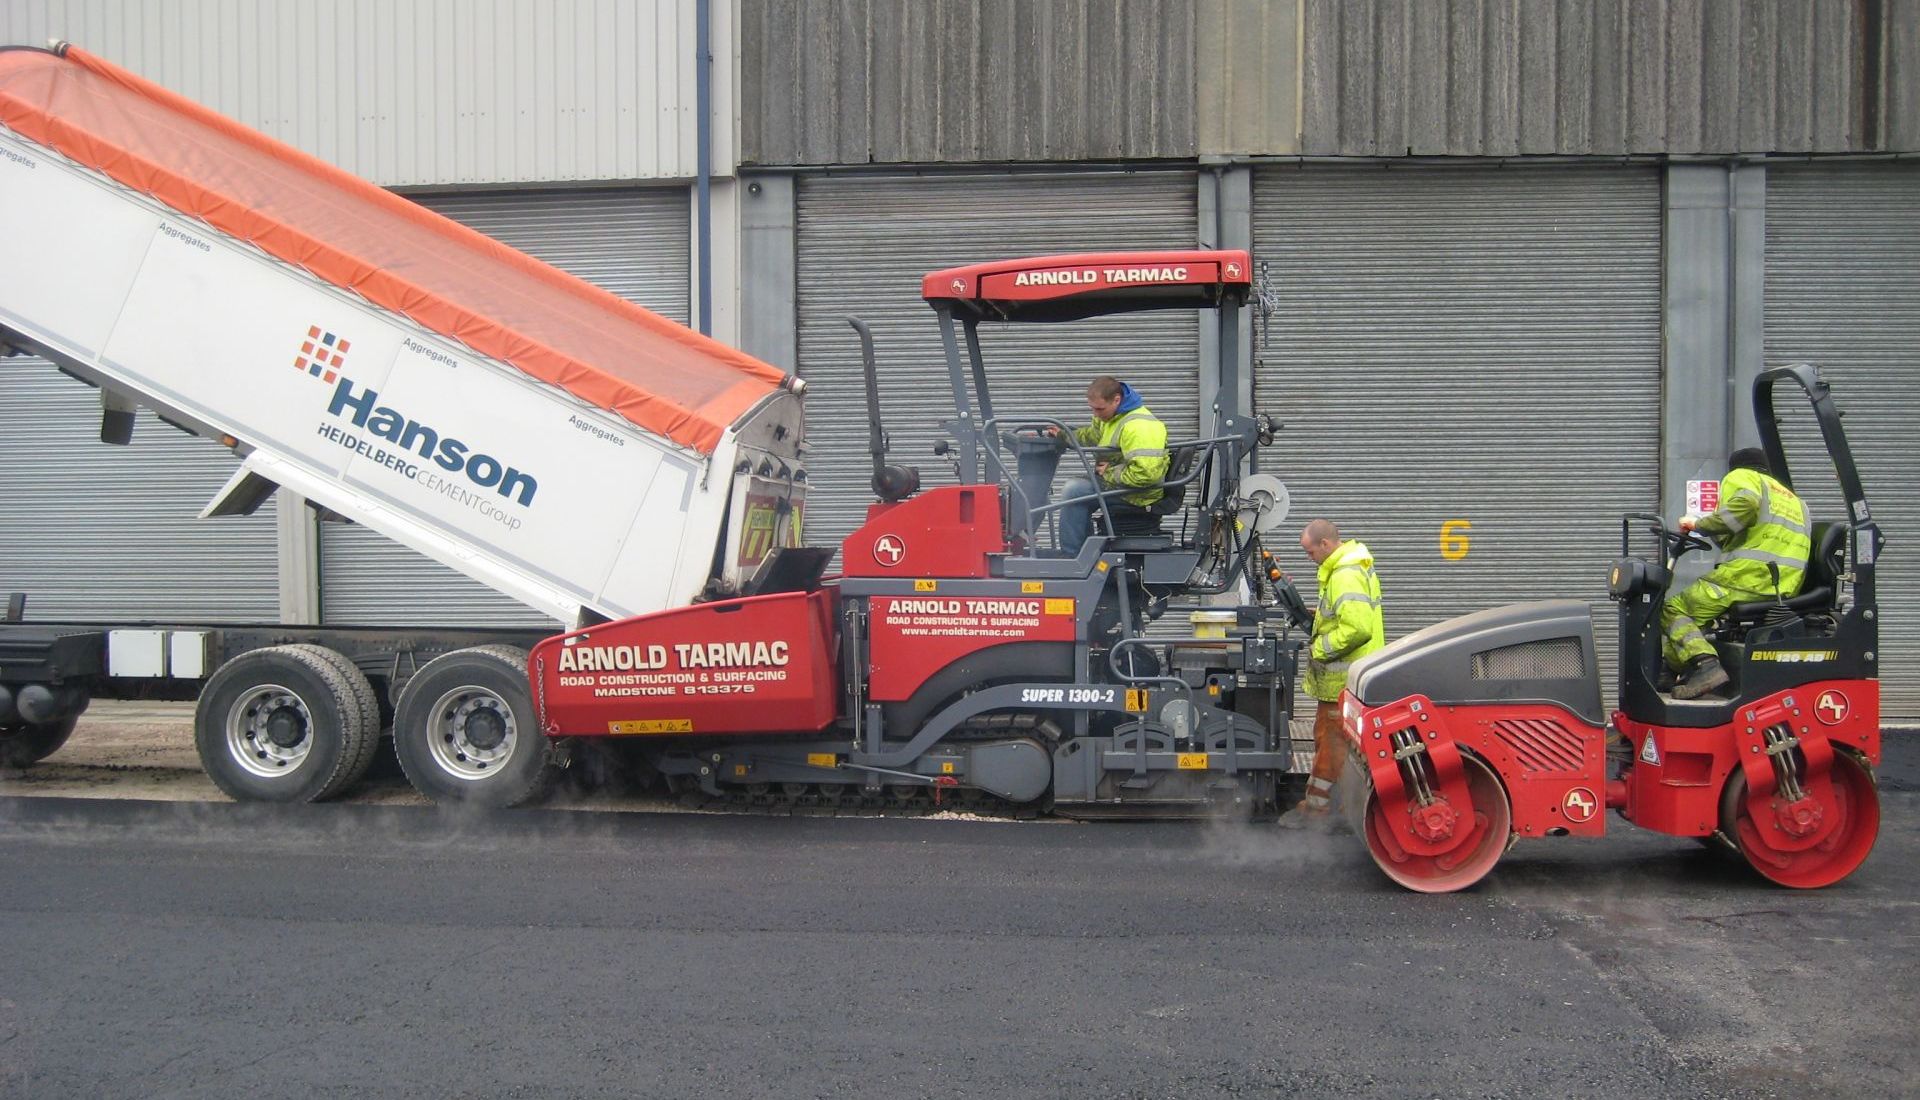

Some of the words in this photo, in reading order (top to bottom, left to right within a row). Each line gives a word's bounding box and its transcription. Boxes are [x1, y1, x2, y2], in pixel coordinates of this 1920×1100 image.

[160, 222, 210, 252] Aggregates
[1015, 271, 1097, 286] ARNOLD
[1103, 267, 1187, 283] TARMAC
[403, 337, 458, 368] Aggregates
[568, 414, 625, 446] Aggregates
[327, 377, 538, 508] Hanson
[877, 538, 902, 561] AT
[1440, 520, 1472, 560] 6
[889, 600, 961, 615] ARNOLD
[966, 601, 1040, 616] TARMAC
[886, 616, 911, 625] ROAD
[913, 617, 979, 626] CONSTRUCTION
[981, 618, 988, 626] &
[991, 618, 1040, 627] SURFACING
[901, 628, 1025, 637] www.arnoldtarmac.com
[559, 645, 668, 673] ARNOLD
[675, 641, 790, 669] TARMAC
[560, 676, 595, 687] ROAD
[599, 673, 695, 686] CONSTRUCTION
[700, 673, 709, 683] &
[713, 671, 787, 682] SURFACING
[594, 686, 676, 697] MAIDSTONE
[684, 684, 755, 695] 813375
[1021, 688, 1065, 703] SUPER
[1068, 689, 1115, 703] 1300-2
[1819, 694, 1845, 720] AT
[1566, 791, 1593, 817] AT
